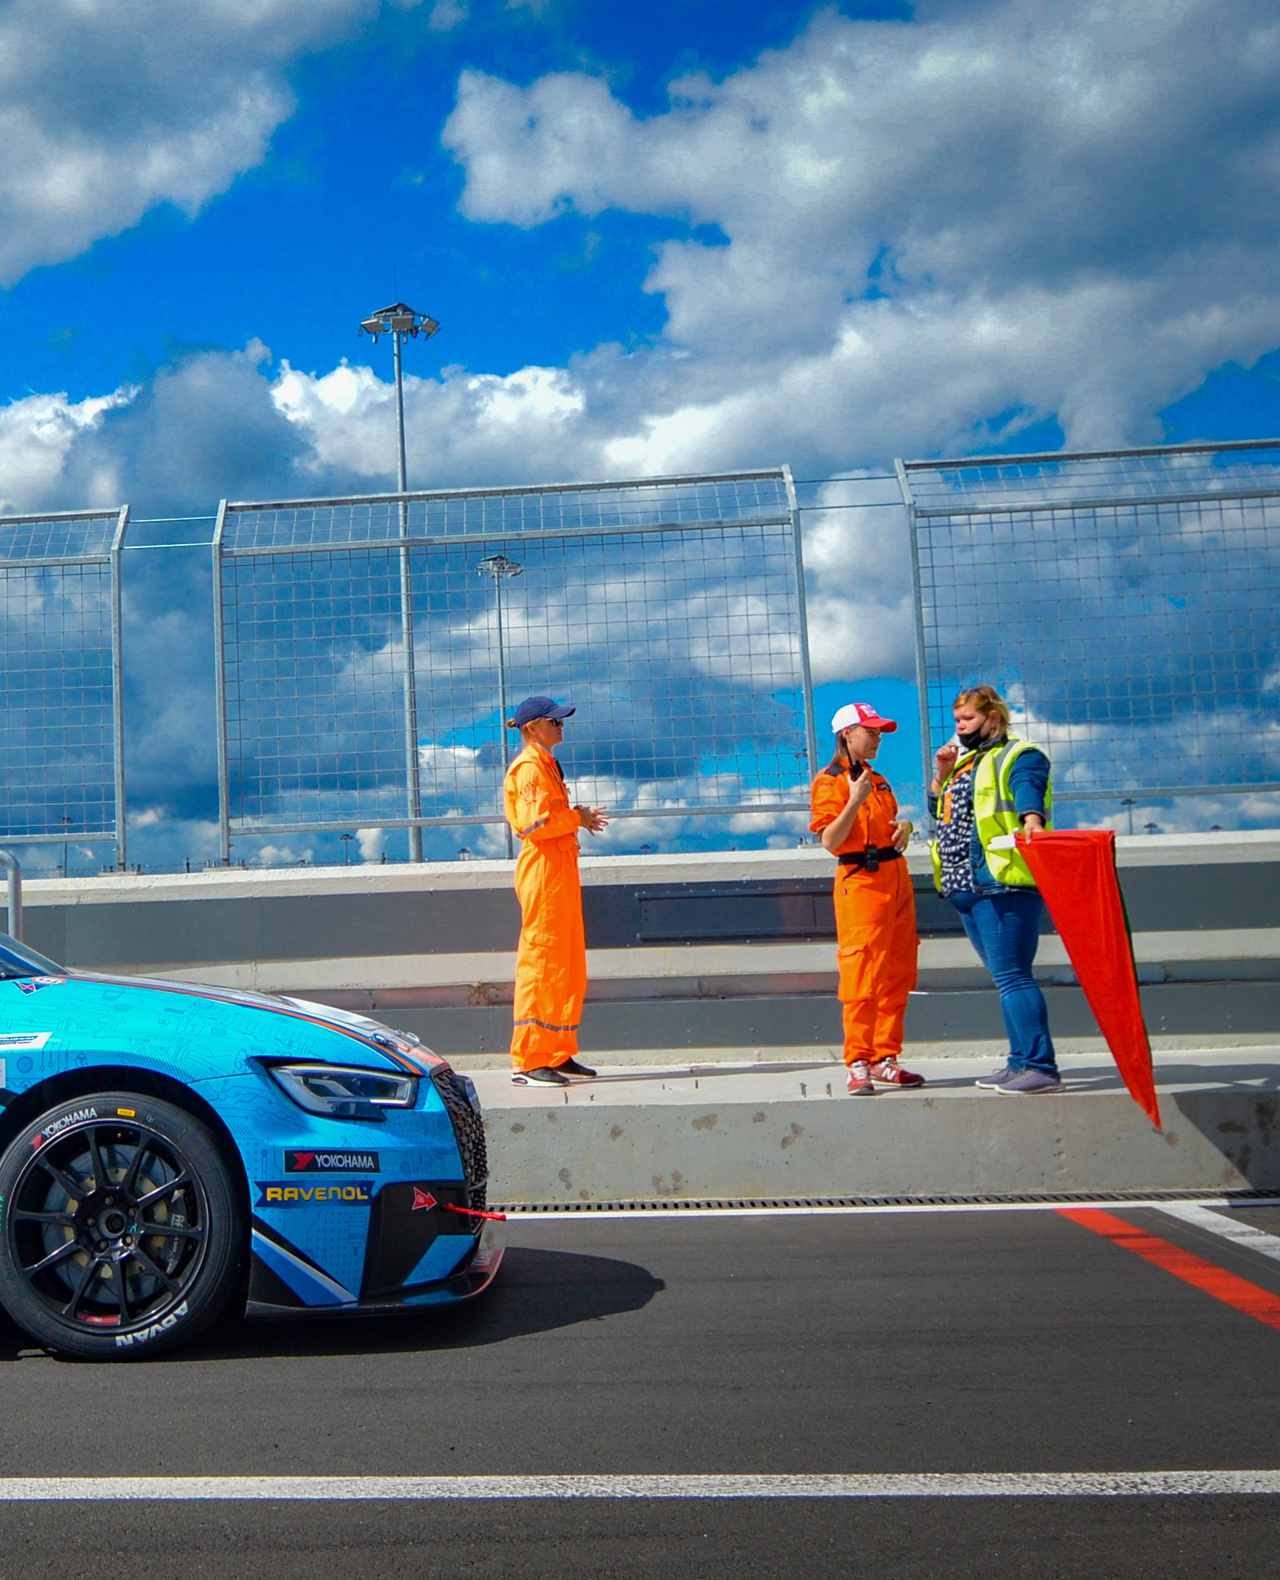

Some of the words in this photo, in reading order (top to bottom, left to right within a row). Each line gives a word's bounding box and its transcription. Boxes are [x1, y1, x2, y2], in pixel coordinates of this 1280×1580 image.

[41, 1107, 98, 1138] YOKOHAMA
[315, 1154, 375, 1169] YOKOHAMA
[266, 1186, 369, 1201] RAVENOL
[115, 1300, 189, 1347] ADVAN
